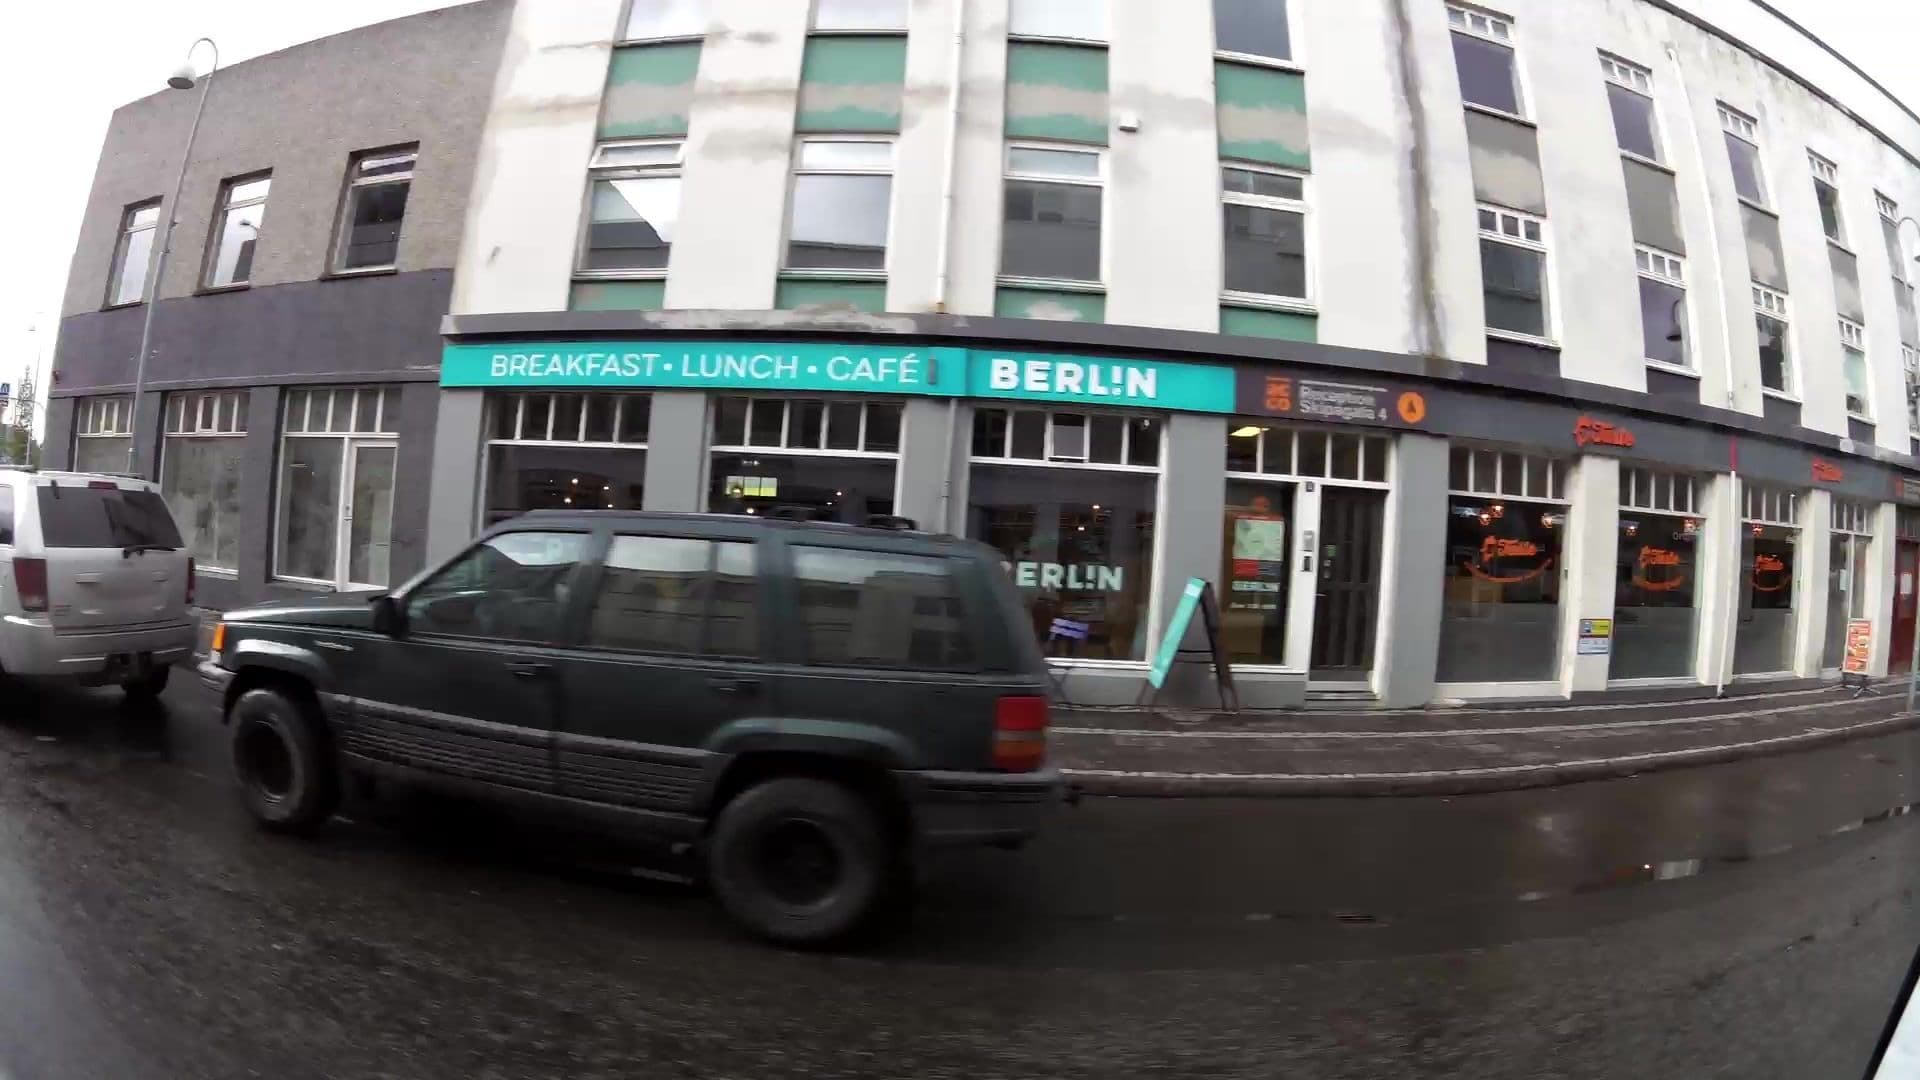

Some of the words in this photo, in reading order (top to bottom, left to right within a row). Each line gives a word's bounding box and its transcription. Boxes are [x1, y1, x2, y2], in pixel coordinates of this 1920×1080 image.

[490, 353, 661, 377] BREAKFAST
[681, 353, 799, 379] LUNCH
[826, 353, 920, 383] CAFÉ
[1378, 407, 1388, 421] 4
[1000, 560, 1123, 591] ERL!N
